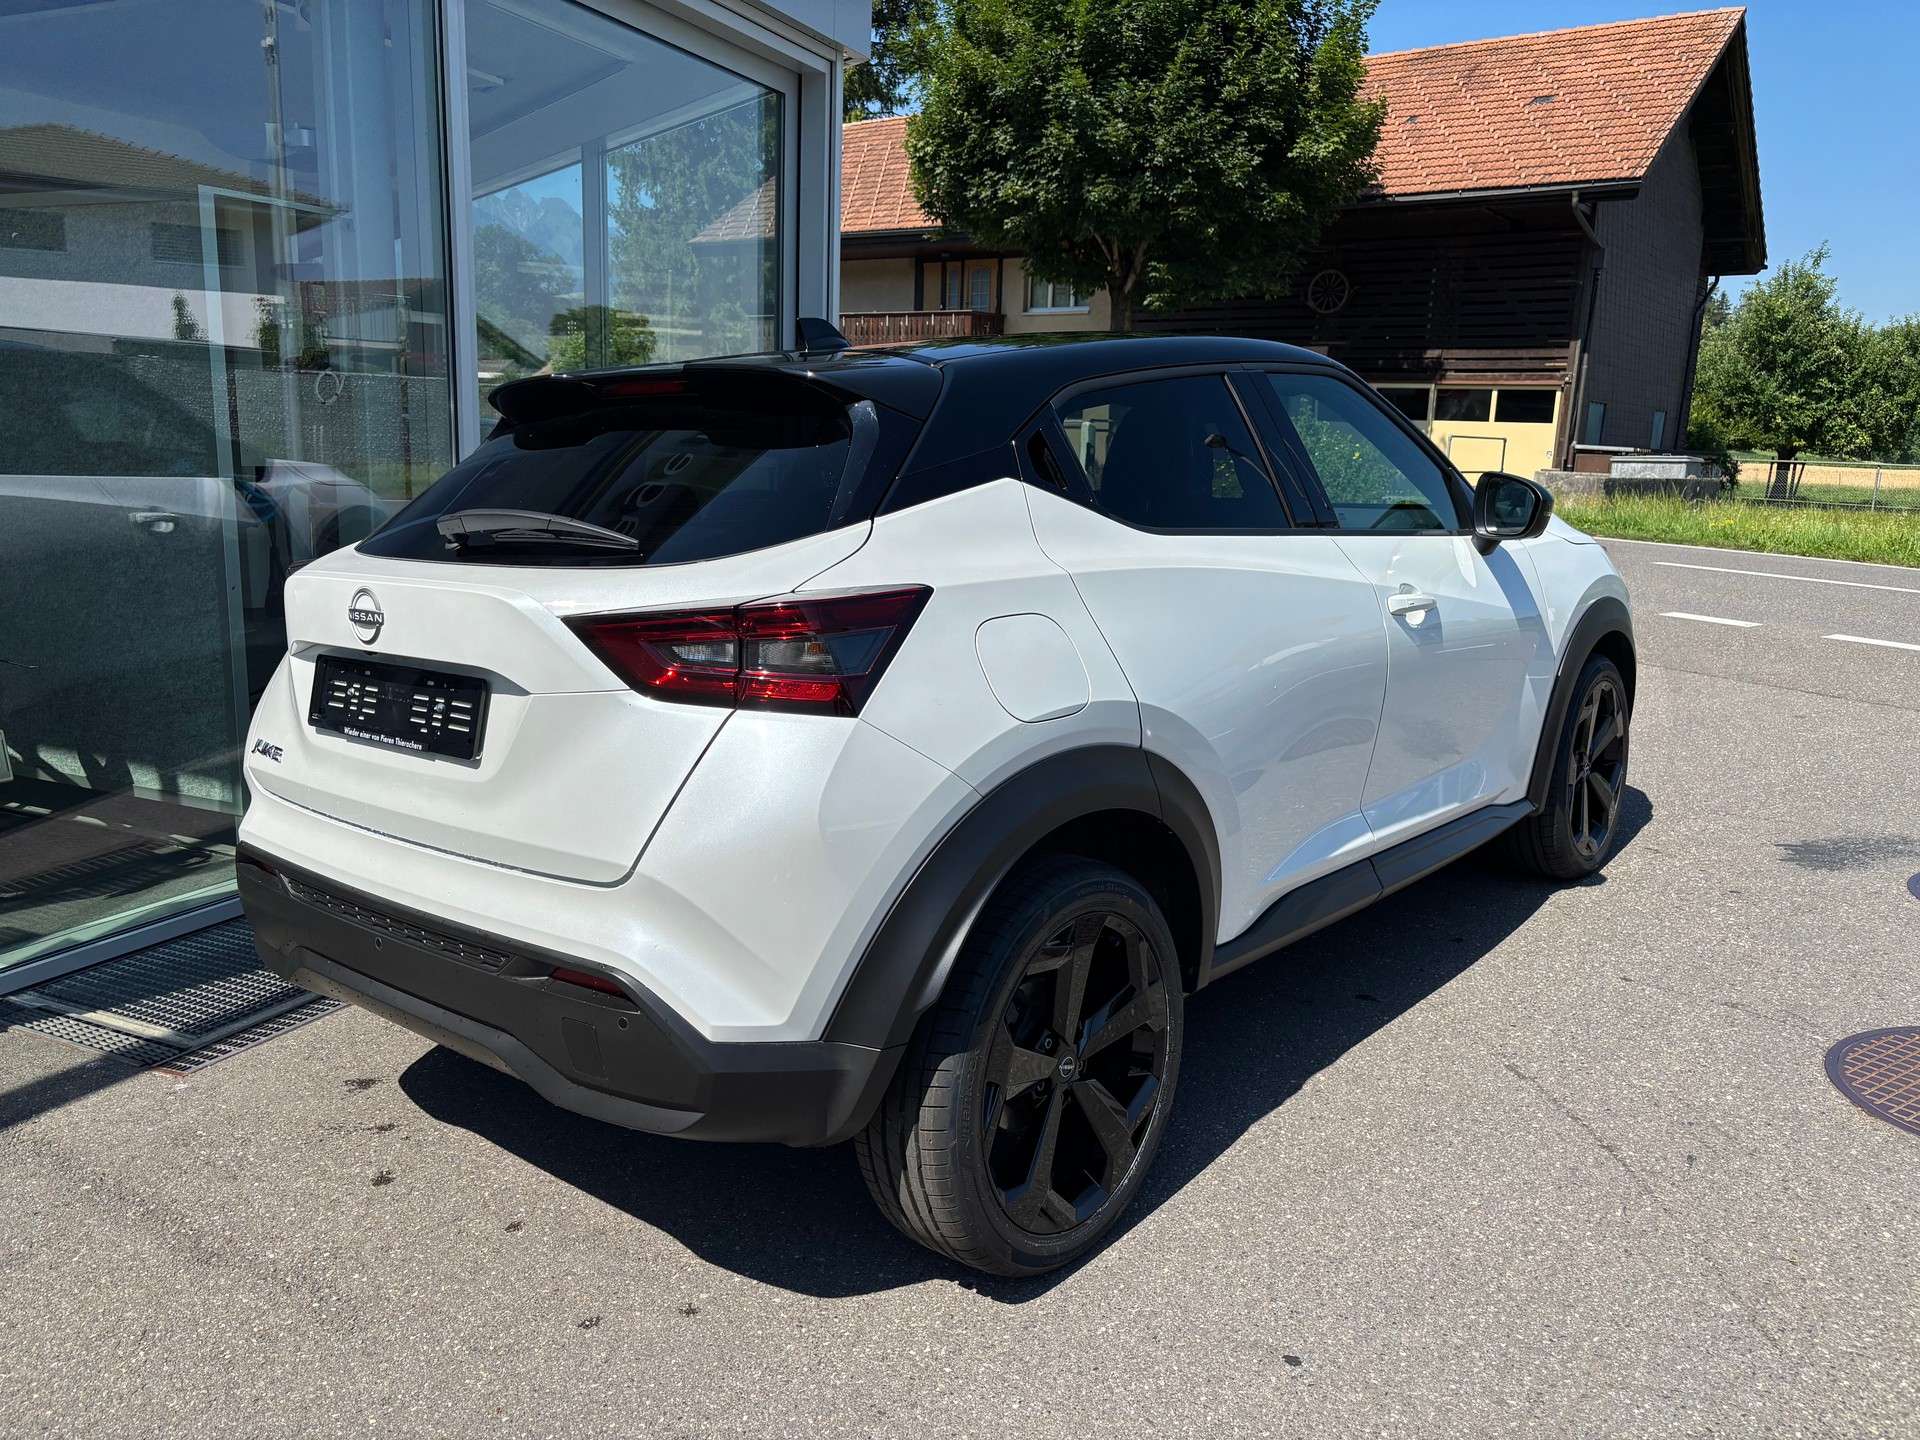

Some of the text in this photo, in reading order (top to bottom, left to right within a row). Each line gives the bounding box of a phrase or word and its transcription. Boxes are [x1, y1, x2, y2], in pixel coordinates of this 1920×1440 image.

[349, 610, 383, 624] NISSAN
[344, 726, 360, 737] Wieder
[360, 730, 371, 740] einer
[251, 738, 284, 764] JUKE
